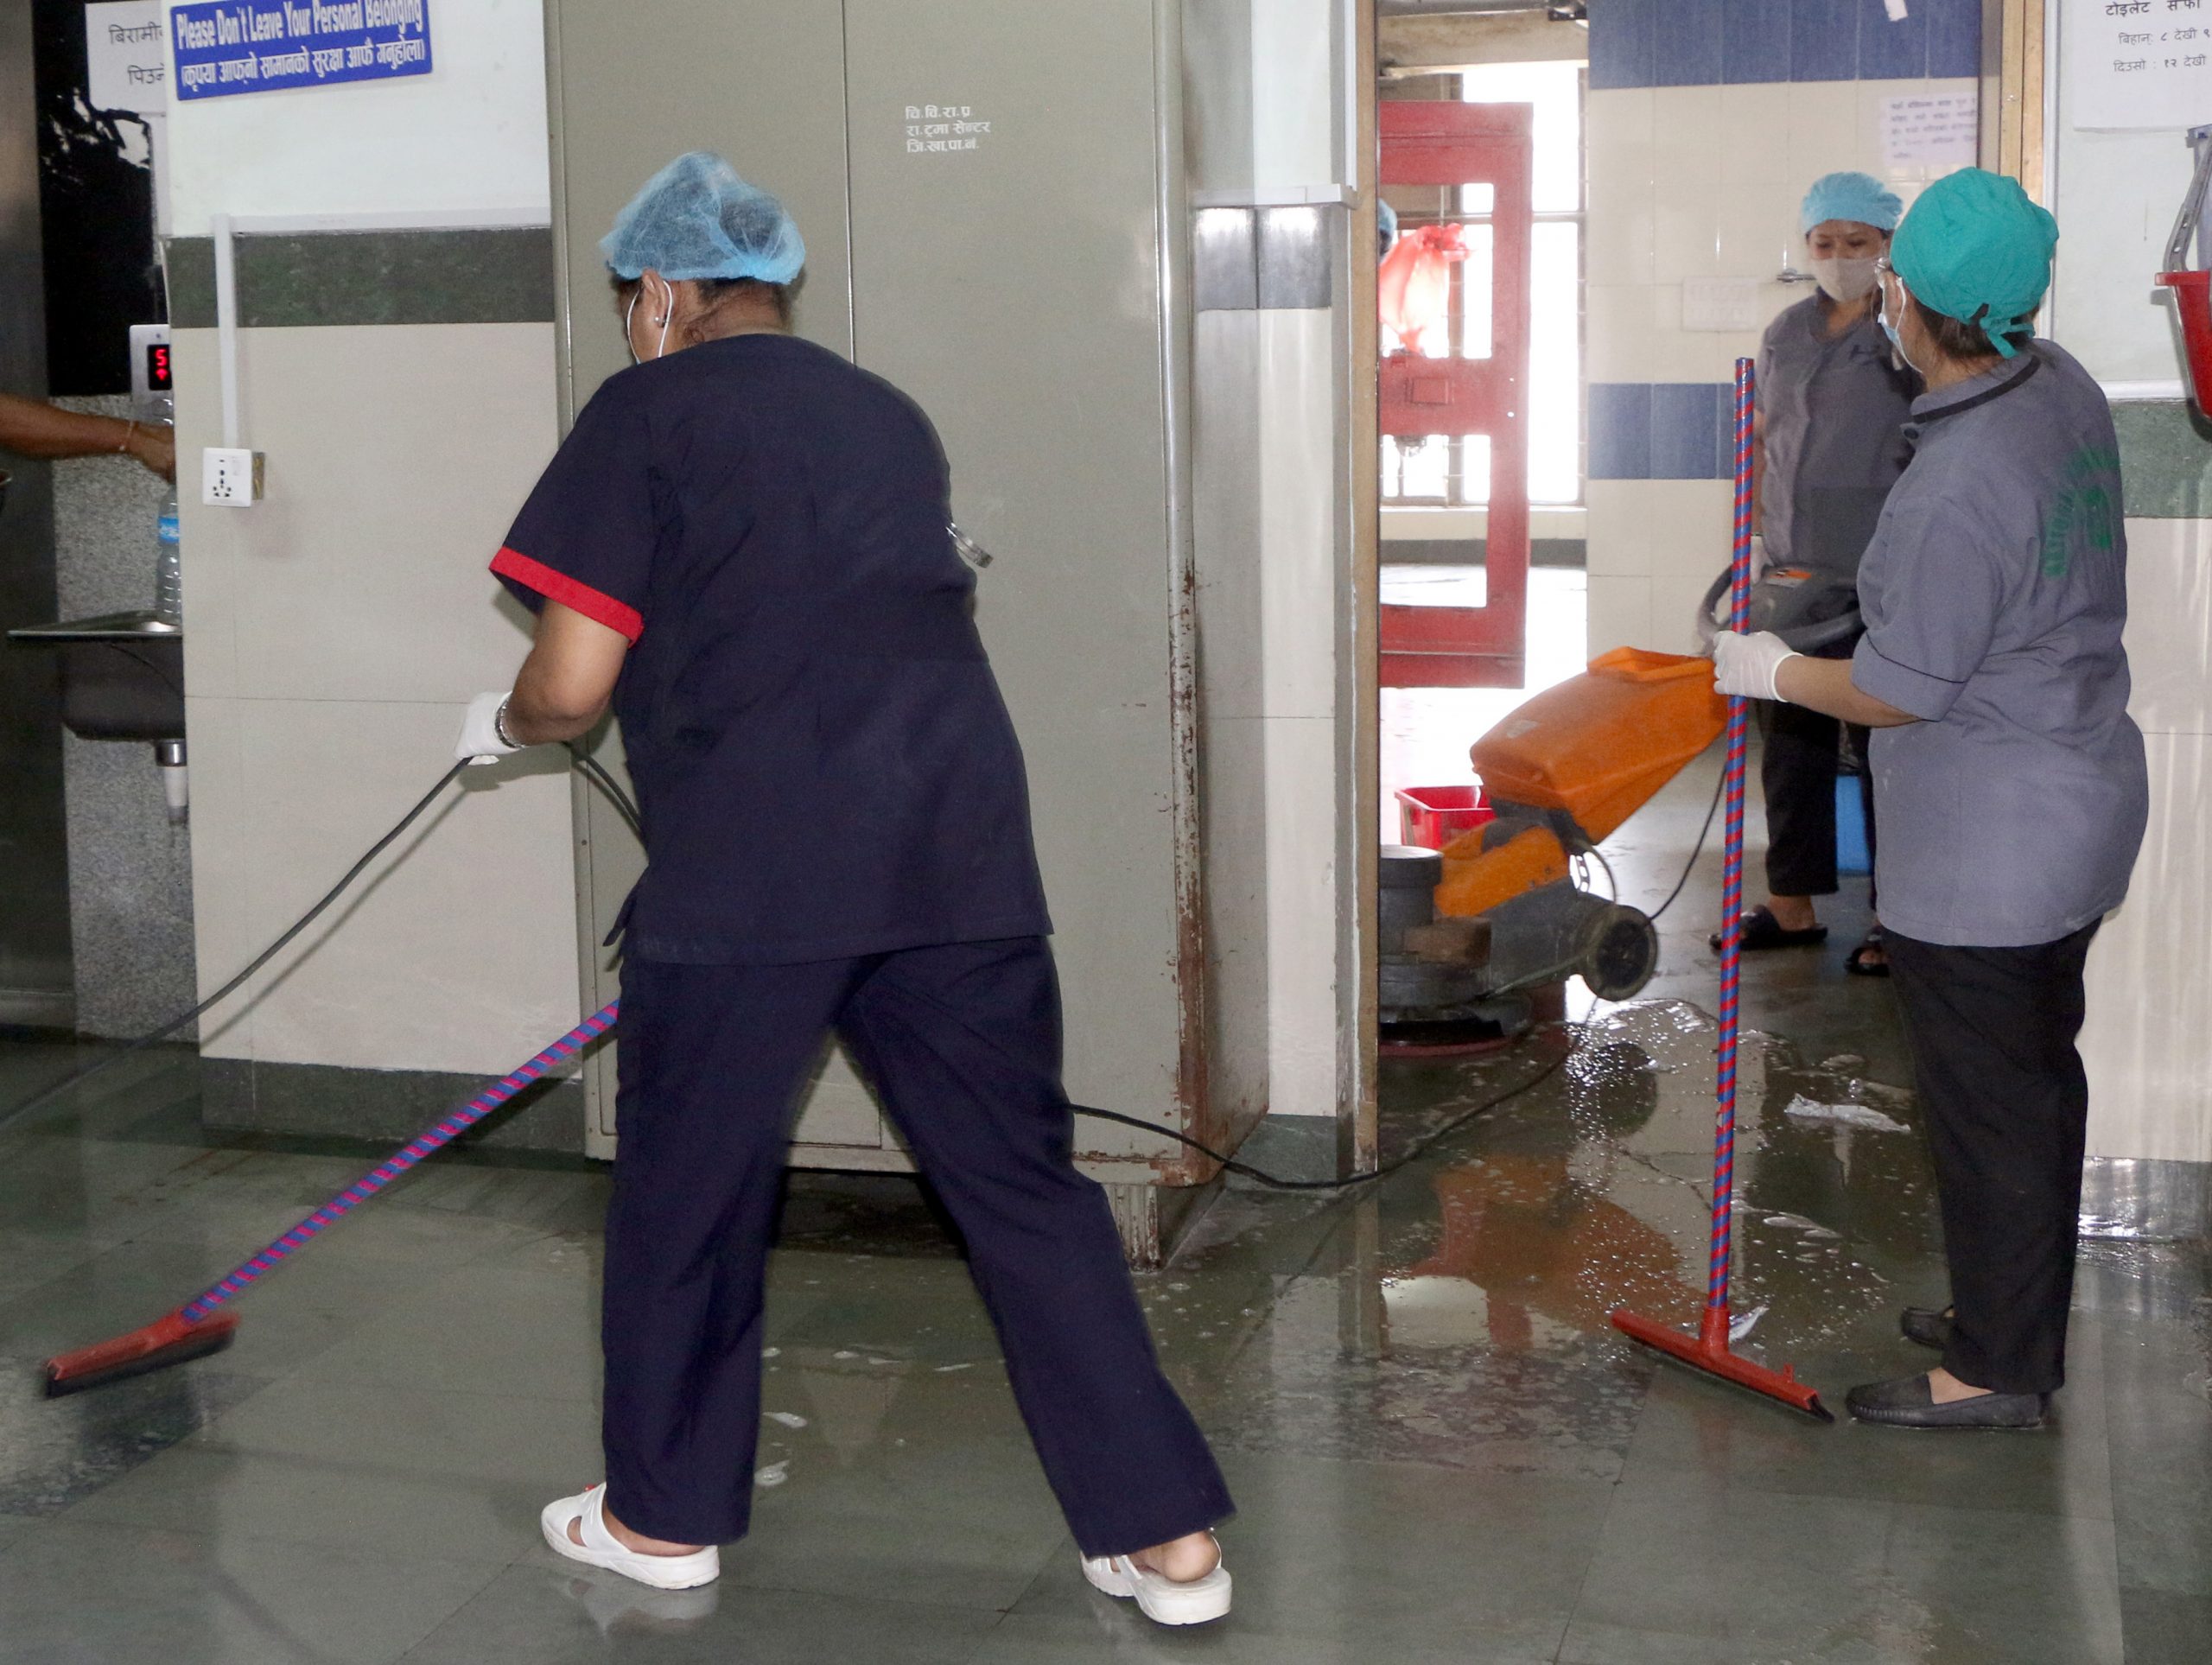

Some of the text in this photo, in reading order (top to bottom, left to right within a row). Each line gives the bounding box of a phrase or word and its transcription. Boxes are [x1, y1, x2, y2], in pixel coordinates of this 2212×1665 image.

[108, 21, 162, 45] बिरामी
[175, 0, 423, 50] Please Don't Leave Your Personal Belonging
[259, 45, 310, 79] सामानको
[311, 48, 345, 79] सुरक्षा
[156, 348, 167, 366] 5
